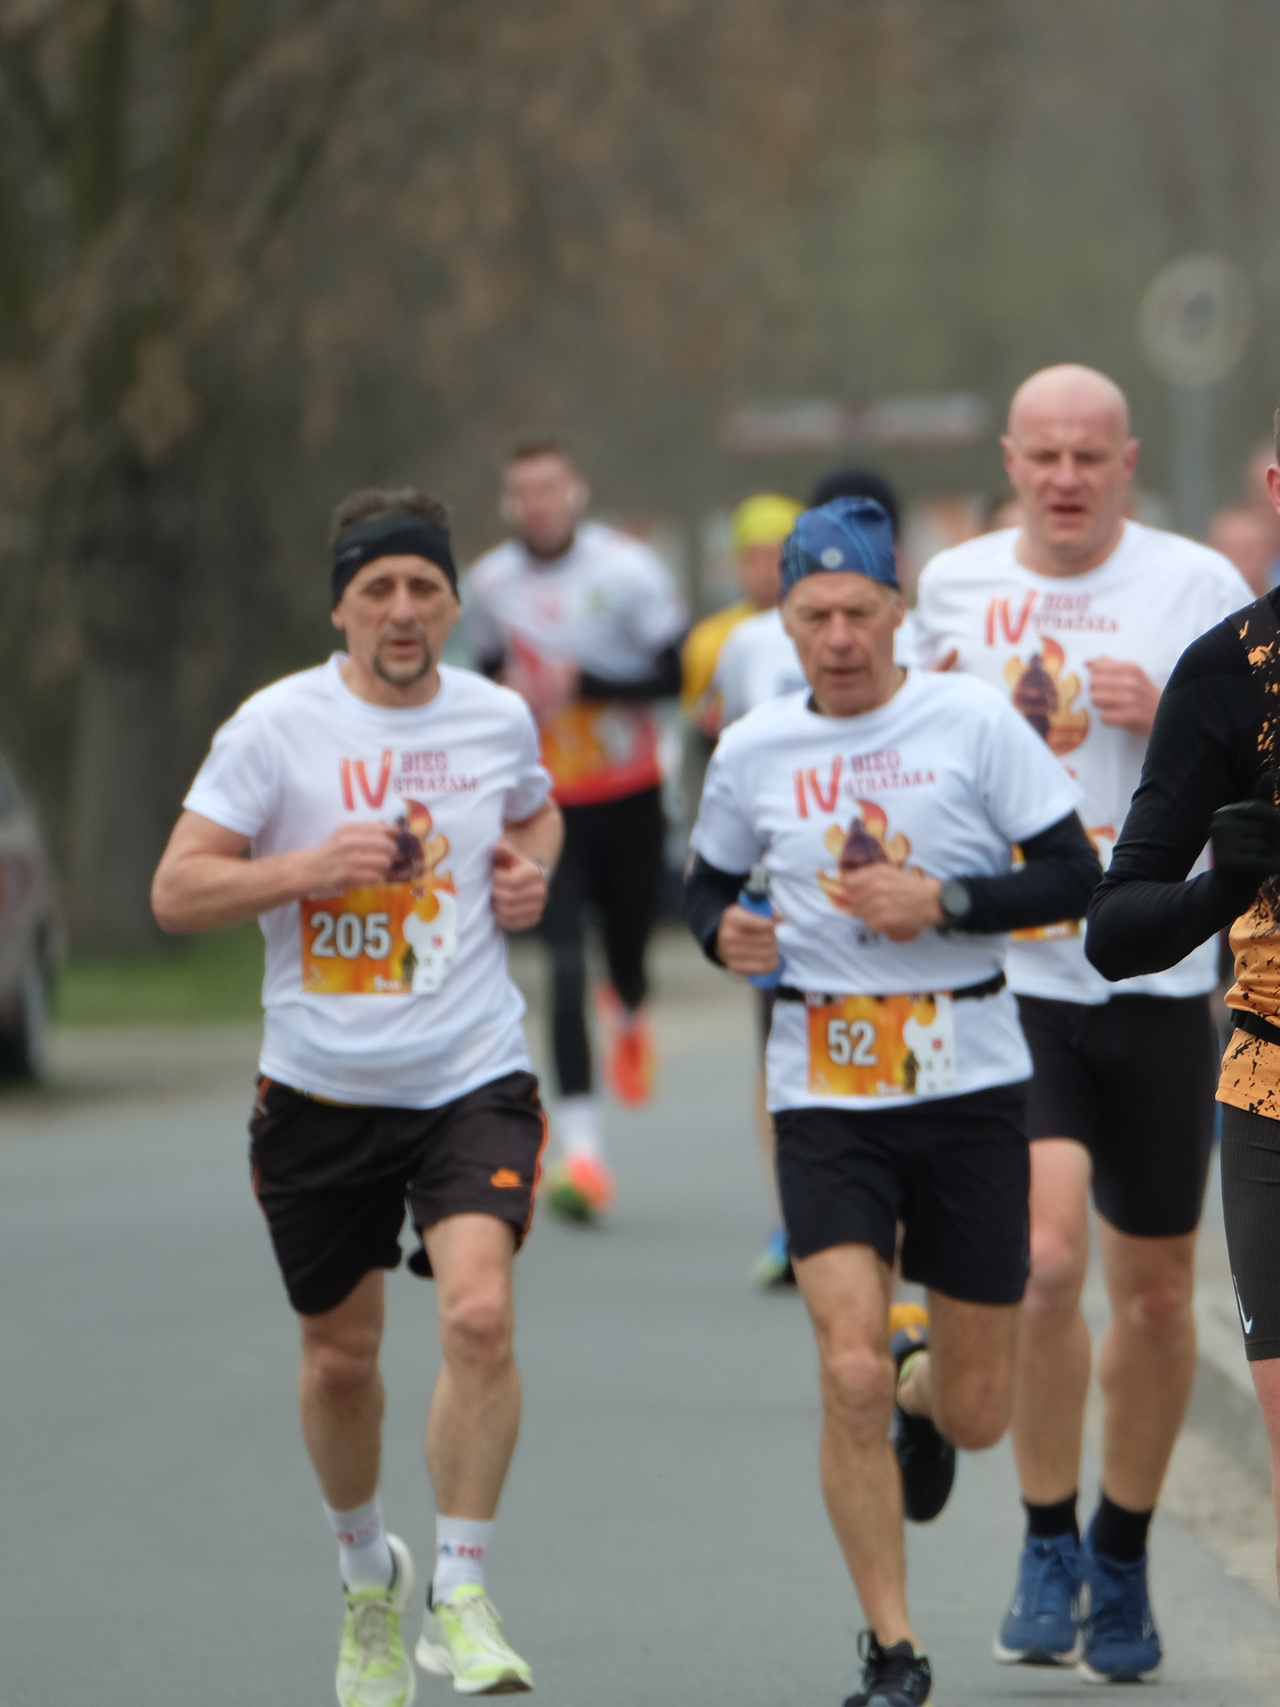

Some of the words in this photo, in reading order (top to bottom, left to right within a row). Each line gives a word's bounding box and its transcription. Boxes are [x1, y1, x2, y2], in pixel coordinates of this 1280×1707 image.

[984, 588, 1038, 648] IV
[339, 749, 392, 811] IV
[402, 751, 448, 773] BIEG
[851, 749, 901, 773] BIEG
[795, 754, 843, 819] IV
[310, 912, 391, 960] 205
[828, 1019, 879, 1066] 52
